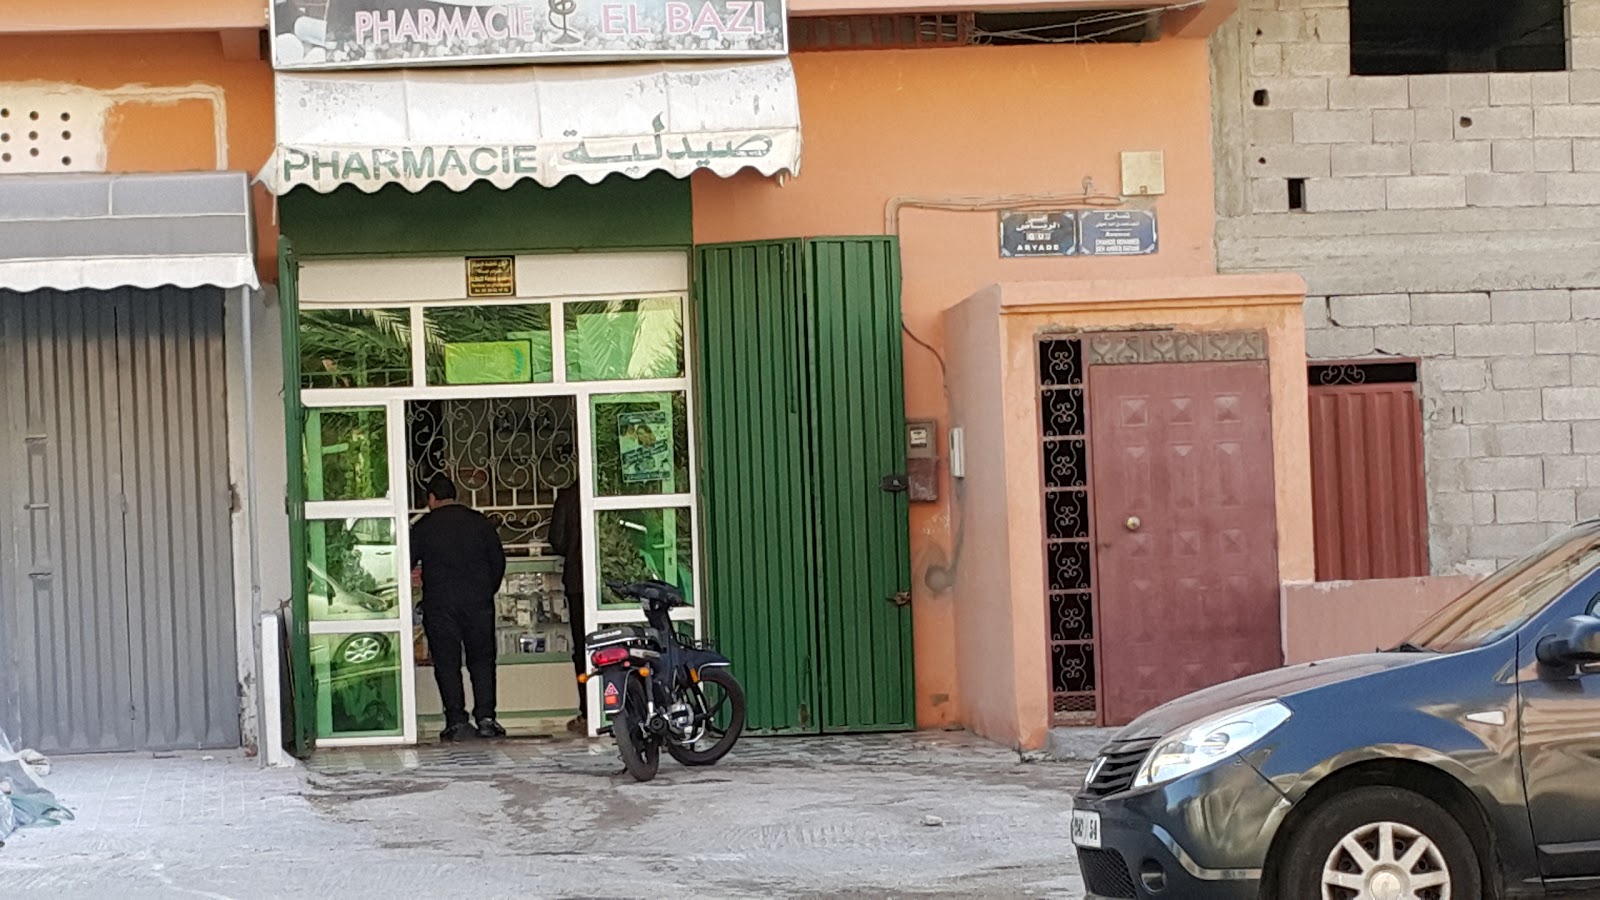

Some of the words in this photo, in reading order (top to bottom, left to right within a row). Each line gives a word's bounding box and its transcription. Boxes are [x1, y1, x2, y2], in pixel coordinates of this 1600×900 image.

[354, 6, 535, 45] PHARMACIE
[601, 4, 650, 34] EL
[667, 0, 766, 34] BAZI
[284, 145, 538, 181] PHARMACIE
[562, 111, 772, 173] صيدلية
